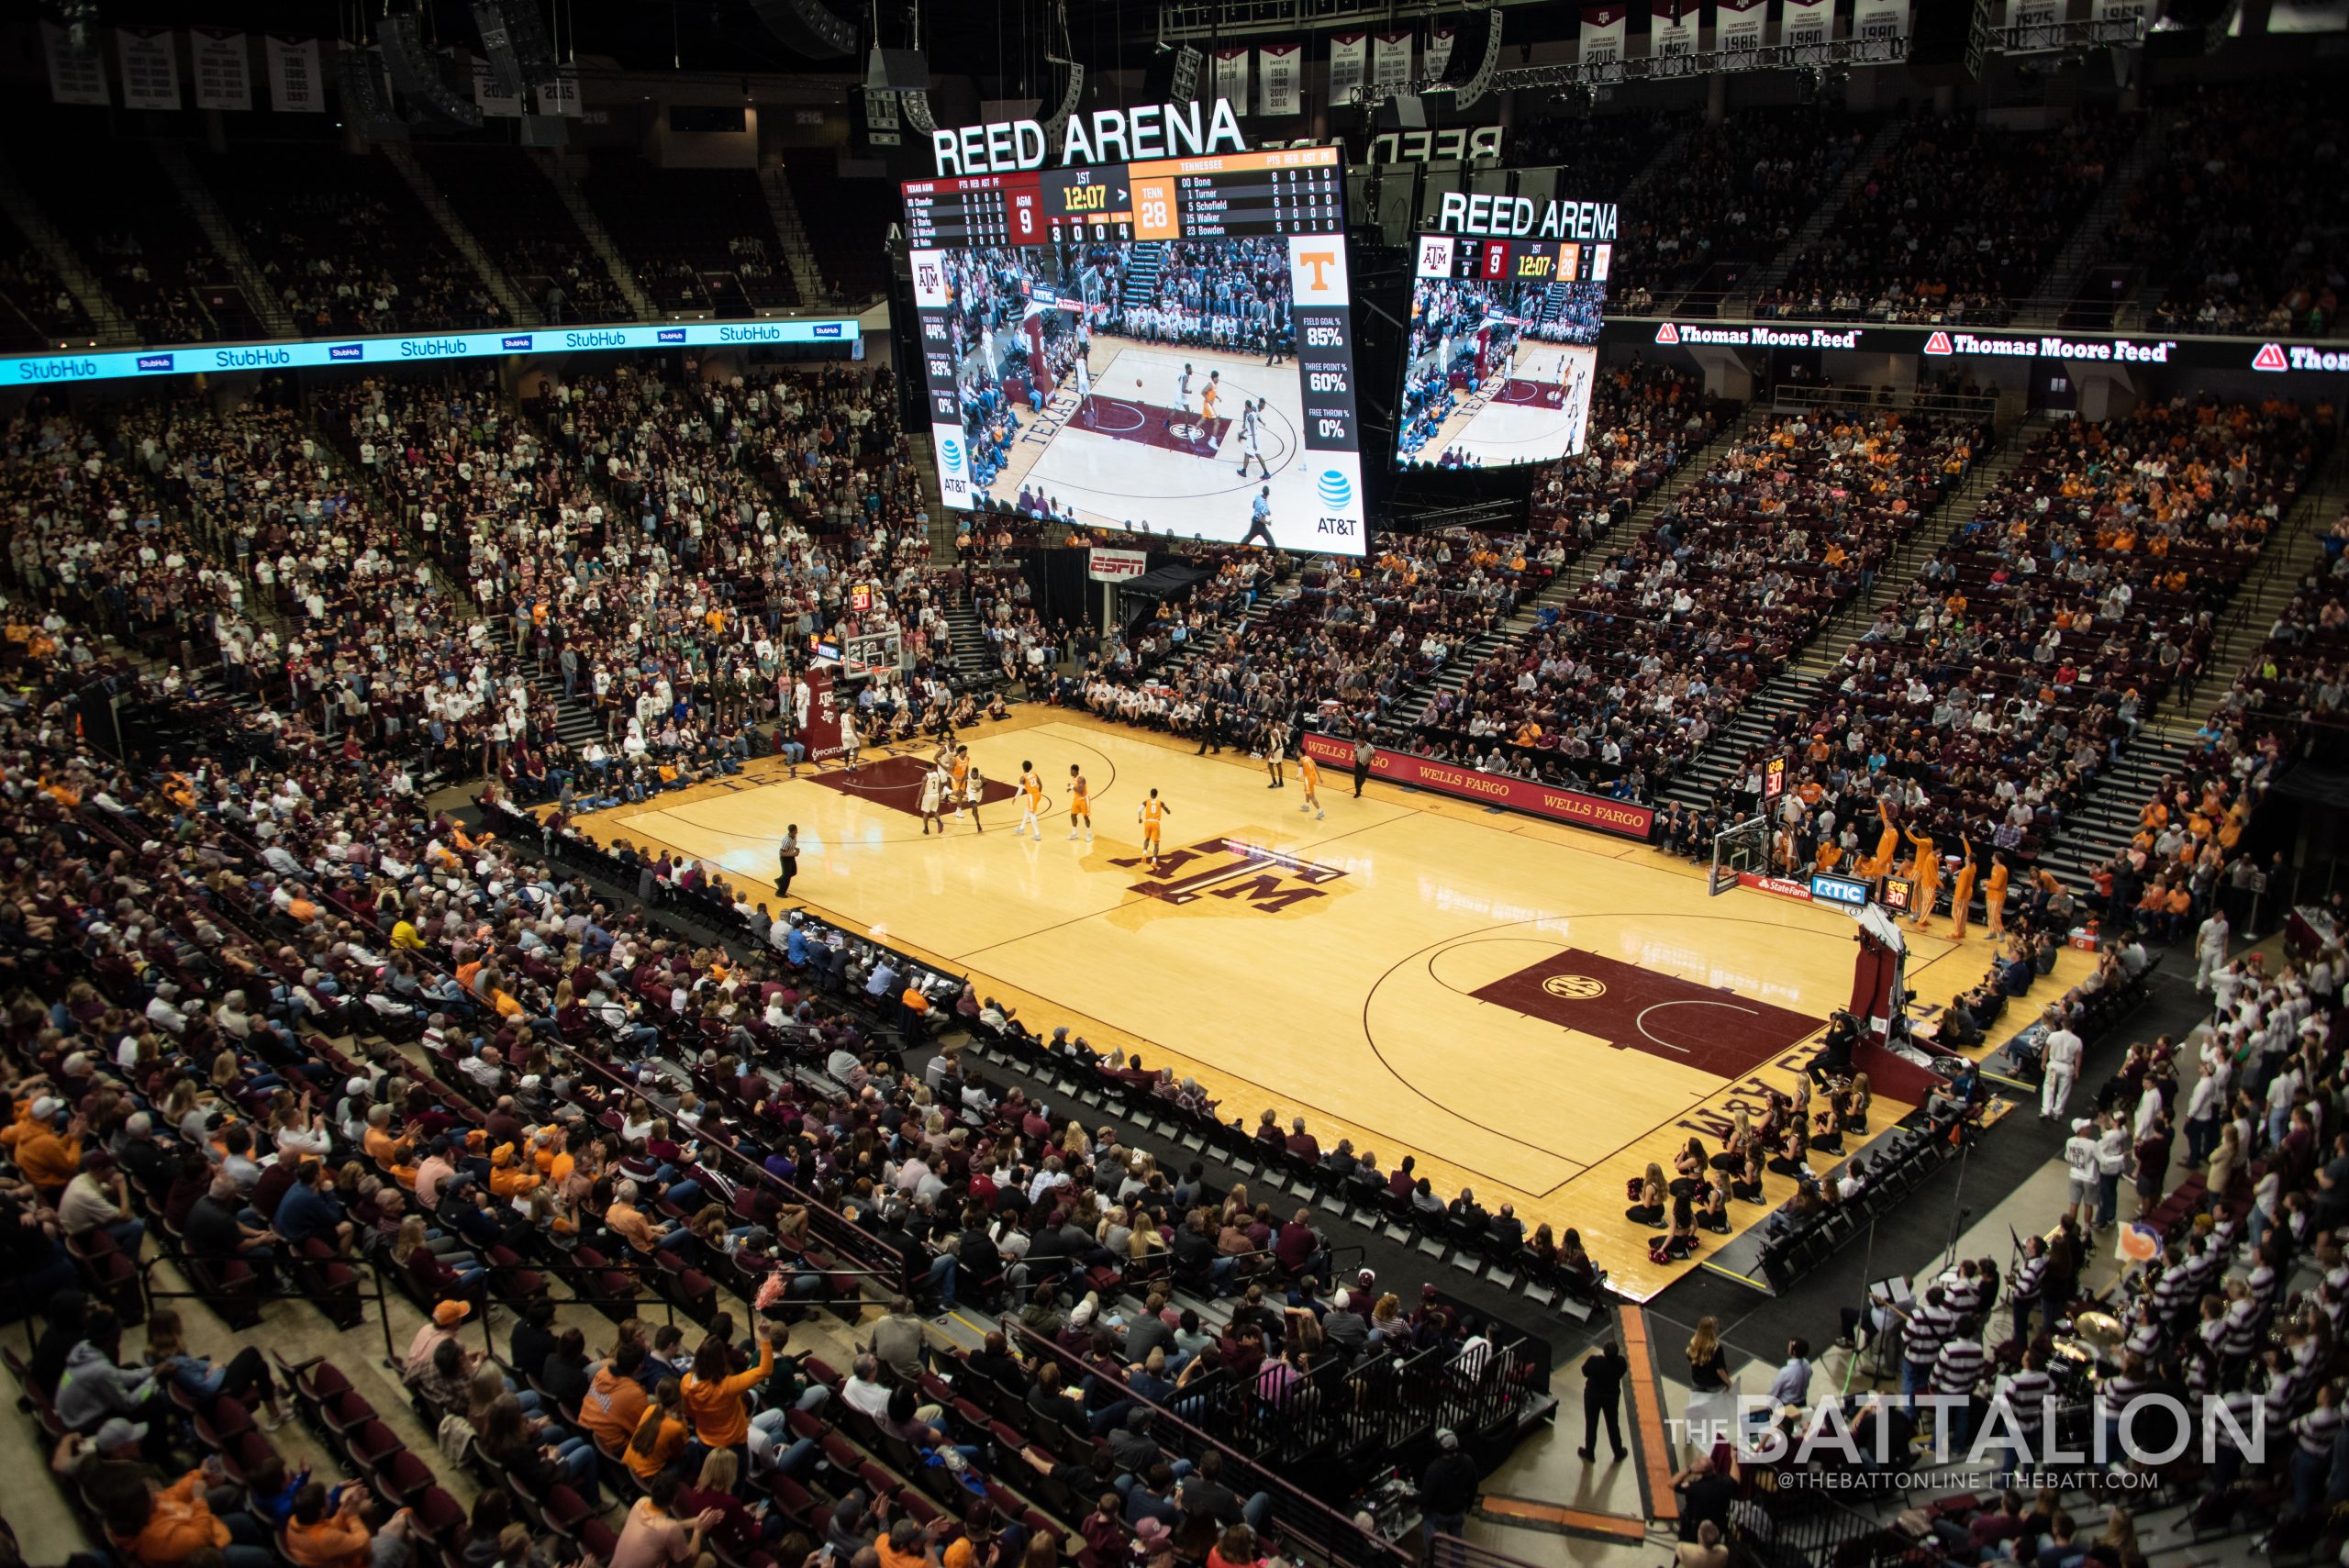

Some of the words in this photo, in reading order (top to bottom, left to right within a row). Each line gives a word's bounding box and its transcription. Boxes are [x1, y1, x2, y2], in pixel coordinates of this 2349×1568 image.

[1271, 68, 1288, 77] 1969
[1270, 88, 1288, 97] 2007
[1270, 99, 1287, 107] 2016
[933, 120, 1046, 177] REED
[1062, 98, 1246, 165] ARENA
[1180, 160, 1223, 171] TENNESSEE
[1267, 156, 1280, 166] PTS
[1285, 154, 1298, 164] REB
[1303, 153, 1315, 163] AST
[1321, 151, 1330, 161] PF
[1076, 172, 1090, 184] 1ST
[1182, 178, 1191, 188] 00
[1194, 178, 1211, 187] Bone
[1272, 172, 1277, 182] 8
[1290, 171, 1295, 181] 0
[1308, 170, 1313, 179] 1
[1324, 168, 1329, 178] 0
[907, 184, 921, 193] TEXAS
[959, 181, 968, 189] PTS
[1142, 187, 1163, 199] TENN
[1195, 189, 1216, 199] Turner
[1273, 184, 1278, 194] 2
[1292, 183, 1296, 193] 1
[1309, 182, 1314, 192] 4
[1325, 181, 1330, 191] 0
[1017, 196, 1032, 207] A&M
[1063, 185, 1106, 211] 12:07
[1196, 200, 1227, 211] Schofield
[1275, 197, 1280, 207] 6
[1293, 196, 1297, 206] 1
[1310, 195, 1315, 205] 0
[1326, 194, 1331, 204] 0
[1020, 209, 1032, 234] 9
[1141, 201, 1167, 228] 28
[1186, 214, 1194, 223] 15
[1197, 213, 1220, 222] Walker
[1275, 209, 1280, 219] 0
[1293, 208, 1298, 218] 0
[1311, 207, 1316, 217] 0
[1327, 207, 1332, 217] 0
[1440, 192, 1534, 235] REED
[1540, 200, 1617, 239] ARENA
[1053, 227, 1061, 242] 3
[1074, 226, 1082, 241] 0
[1096, 224, 1104, 240] 0
[1119, 223, 1128, 239] 4
[1187, 226, 1195, 235] 23
[1198, 226, 1225, 235] Bowden
[1276, 222, 1281, 232] 5
[1294, 221, 1299, 231] 0
[1312, 220, 1317, 230] 1
[1328, 220, 1333, 229] 0
[1466, 245, 1471, 255] 3
[1491, 246, 1503, 254] A&M
[1531, 244, 1542, 254] 1ST
[1300, 252, 1335, 290] T
[1464, 267, 1469, 275] 0
[1491, 255, 1500, 273] 9
[1518, 256, 1551, 276] 12:07
[1561, 258, 1574, 275] 28
[1598, 253, 1607, 272] T
[567, 331, 625, 347] StubHub
[720, 327, 779, 341] StubHub
[926, 324, 946, 339] 44%
[1307, 328, 1343, 345] 85%
[1681, 325, 1748, 344] Thomas
[1752, 328, 1808, 346] Moore
[401, 339, 466, 356] StubHub
[505, 339, 529, 348] StubHub
[1955, 335, 2036, 356] Thomas
[2042, 339, 2110, 359] Moore
[217, 350, 289, 367] StubHub
[333, 348, 359, 357] StubHub
[19, 361, 96, 379] StubHub
[139, 358, 170, 368] StubHub
[930, 361, 951, 376] 33%
[1310, 373, 1346, 392] 60%
[938, 398, 954, 413] 0%
[1319, 419, 1345, 438] 0%
[945, 479, 966, 493] AT&T
[1318, 517, 1357, 536] AT&T
[1091, 556, 1144, 575] ESPN
[852, 585, 868, 594] 12:06
[853, 595, 868, 609] 30
[1308, 741, 1347, 759] WELLS
[1348, 750, 1389, 769] FGO
[1768, 758, 1784, 774] 12:06
[1420, 767, 1463, 786] WELLS
[1465, 776, 1509, 797] FARGO
[1768, 772, 1781, 795] 30
[1544, 795, 1592, 815] WELLS
[1594, 806, 1644, 827] FARGO
[1816, 879, 1861, 900] RTIC
[1889, 880, 1908, 894] 12:06
[1888, 891, 1904, 905] 30
